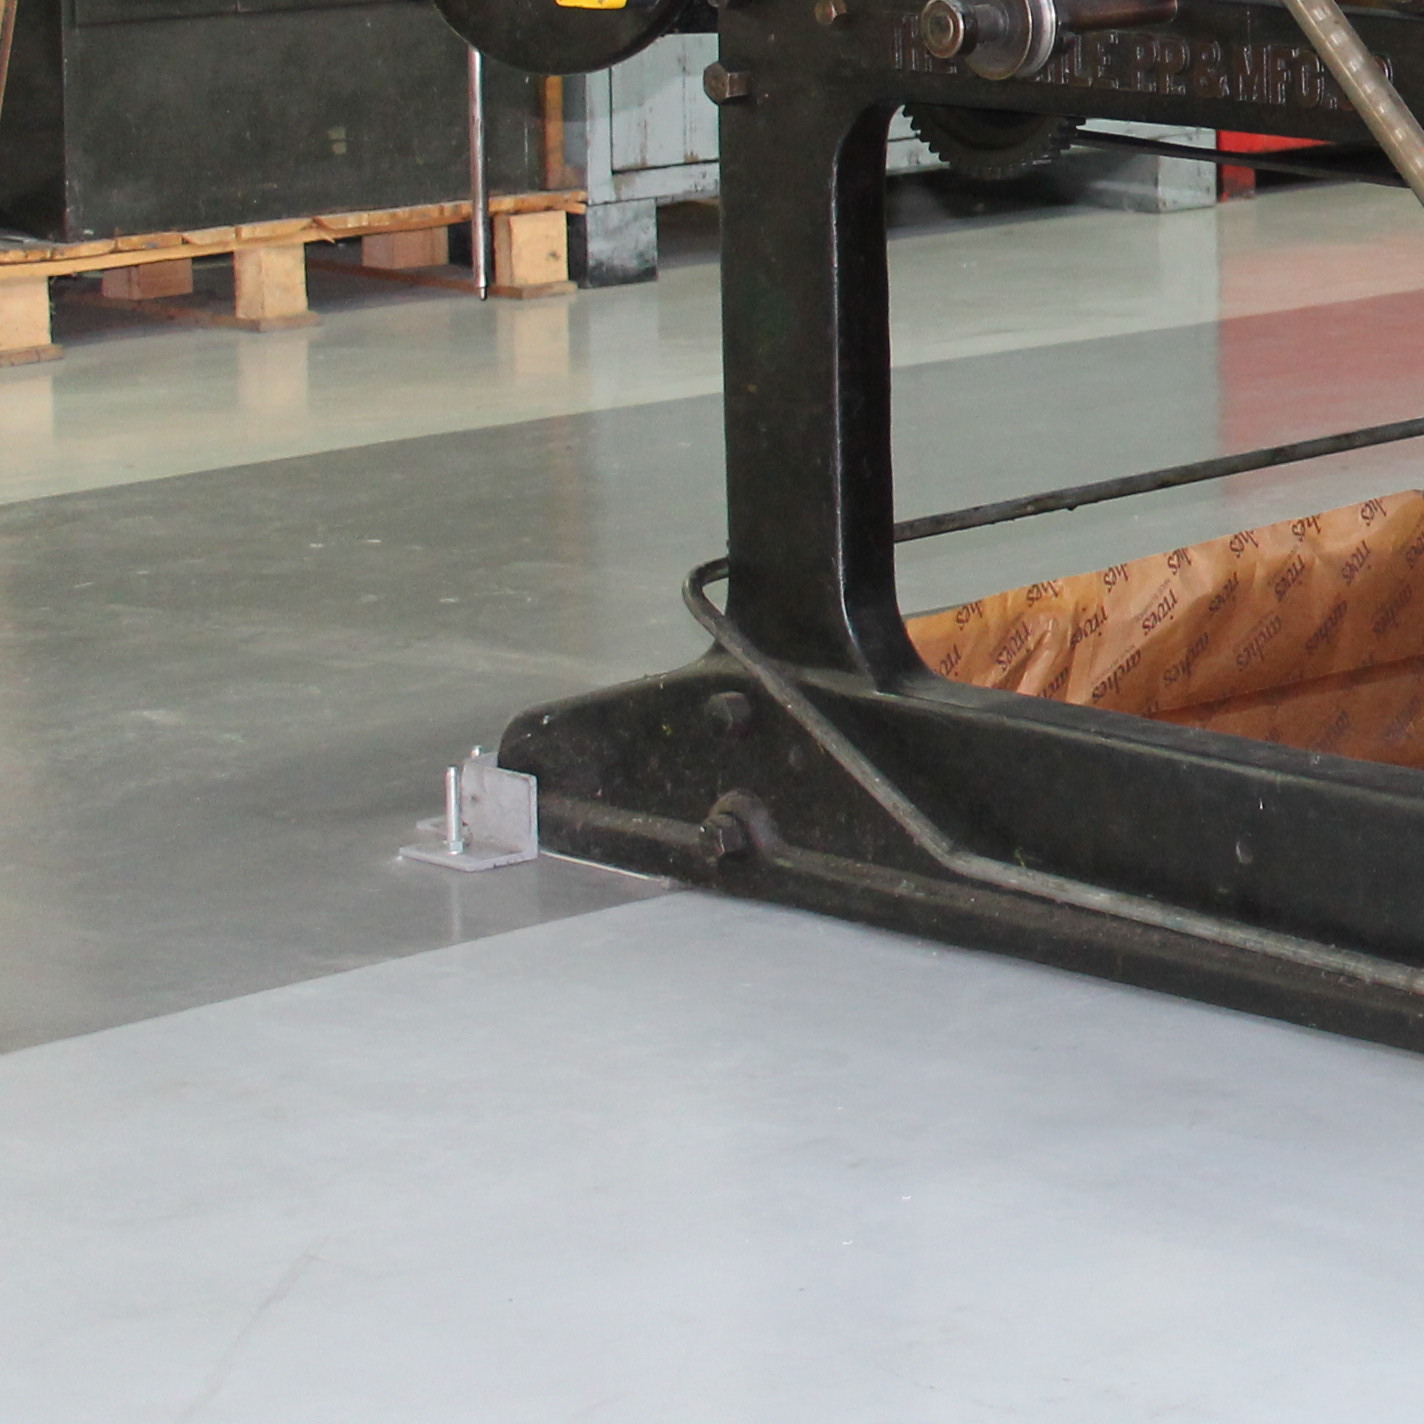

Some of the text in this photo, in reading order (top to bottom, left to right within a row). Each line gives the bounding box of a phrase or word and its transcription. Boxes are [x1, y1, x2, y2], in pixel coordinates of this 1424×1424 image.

[1209, 571, 1241, 617] rives
[1274, 555, 1306, 603] rives
[1140, 587, 1179, 636] rives
[996, 620, 1033, 672] rives
[1236, 614, 1283, 672] arches
[1092, 649, 1143, 701] arches
